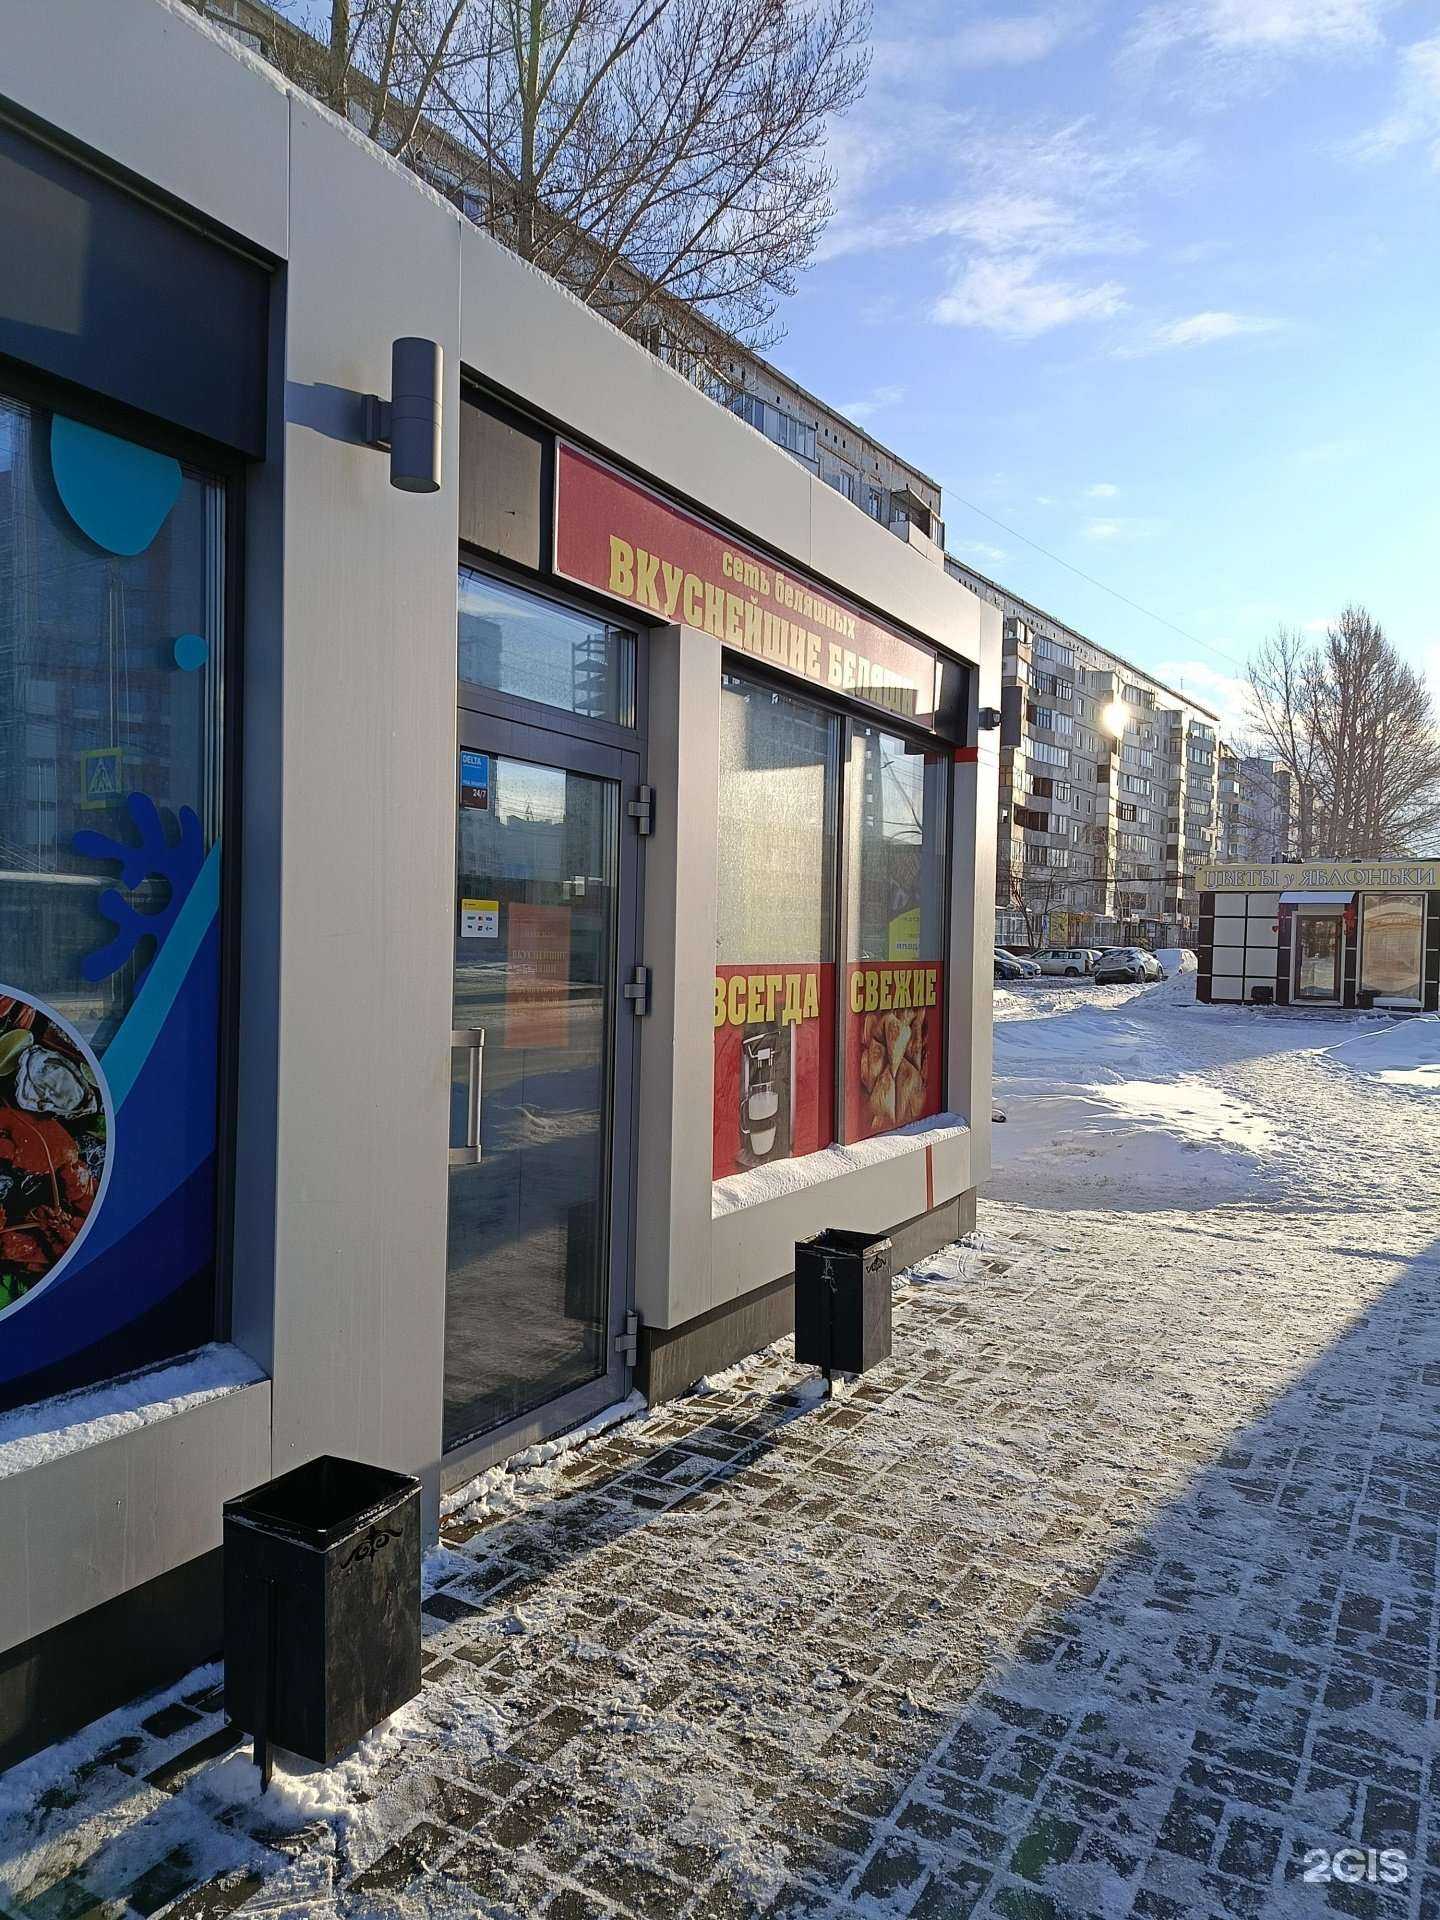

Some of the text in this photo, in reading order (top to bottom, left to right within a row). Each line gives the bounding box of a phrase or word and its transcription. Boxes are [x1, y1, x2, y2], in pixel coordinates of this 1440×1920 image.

[608, 534, 822, 680] ВКУСНЕЙШИЕ
[722, 551, 857, 640] сеть беляшных
[1205, 869, 1279, 889] ЦВЕТЫ
[1299, 868, 1436, 887] ЯБЛОНЬКИ
[714, 969, 937, 1027] ВСЕГДА СВЕЖИЕ
